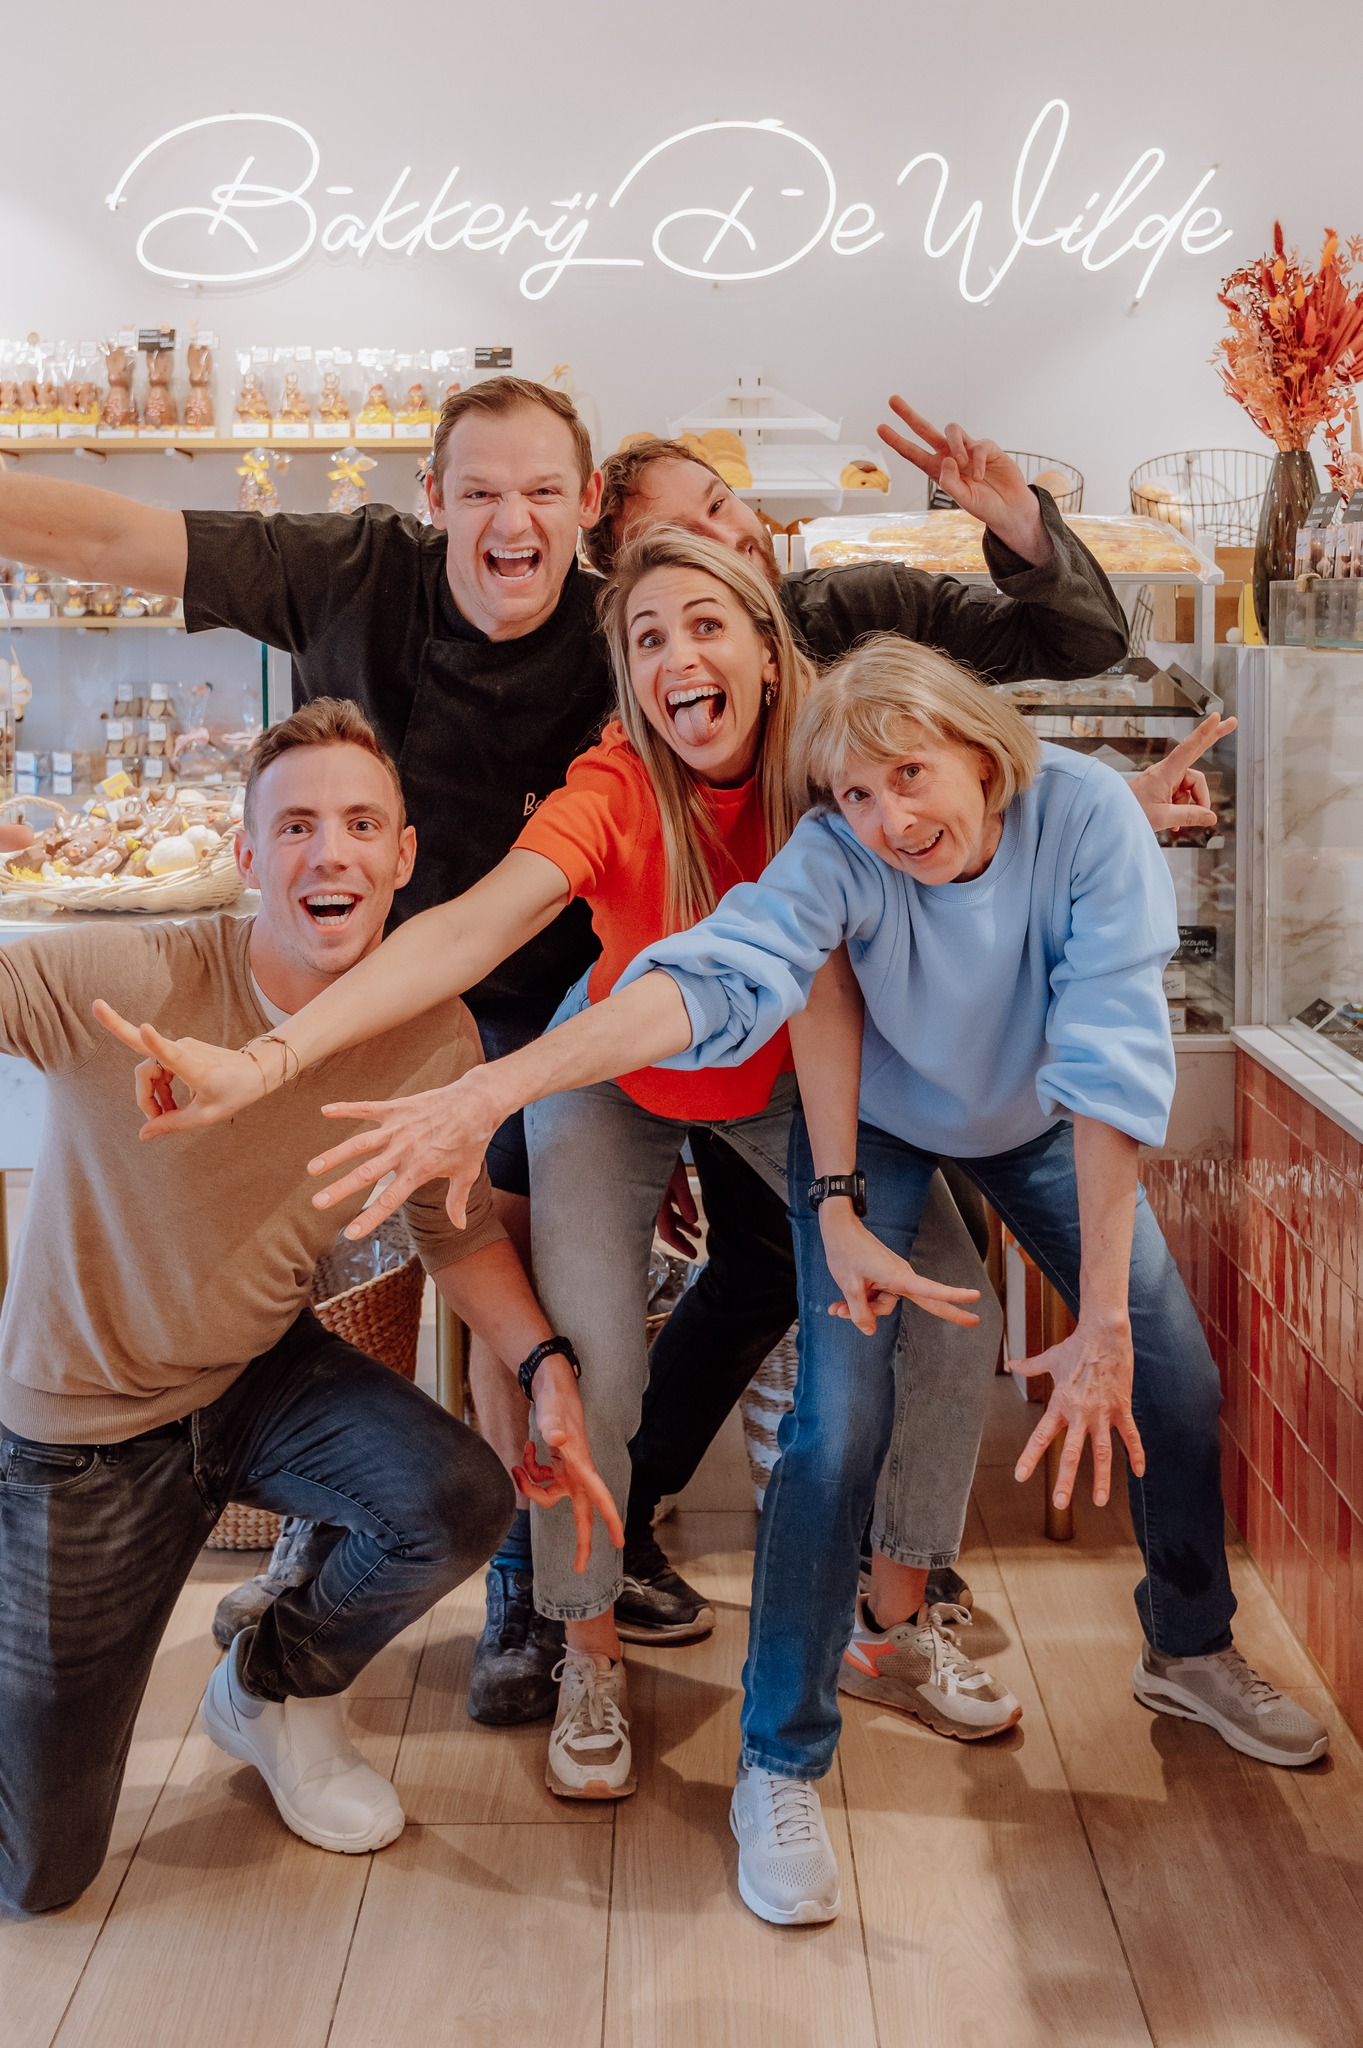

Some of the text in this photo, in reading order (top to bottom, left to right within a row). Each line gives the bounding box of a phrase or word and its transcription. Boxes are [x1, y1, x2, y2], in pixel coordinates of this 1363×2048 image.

[106, 99, 1233, 303] Bakkerij De Wilde
